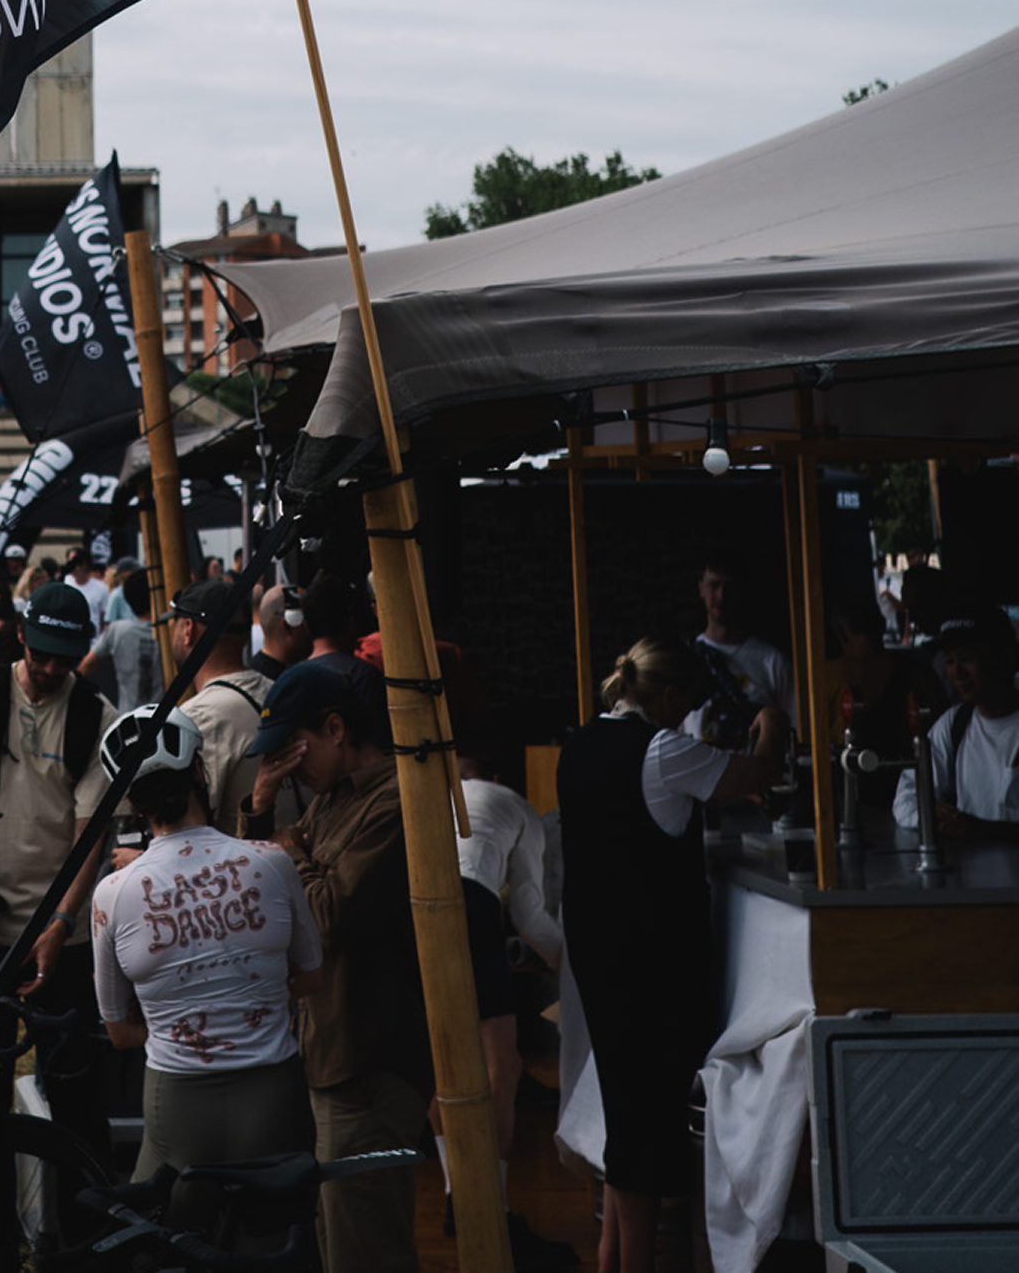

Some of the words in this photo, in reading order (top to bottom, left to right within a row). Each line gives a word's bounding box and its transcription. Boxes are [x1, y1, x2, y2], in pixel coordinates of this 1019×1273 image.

[27, 233, 96, 346] DIOS
[20, 335, 50, 385] CLUB
[142, 855, 250, 912] LAST
[143, 886, 267, 955] DANCE
